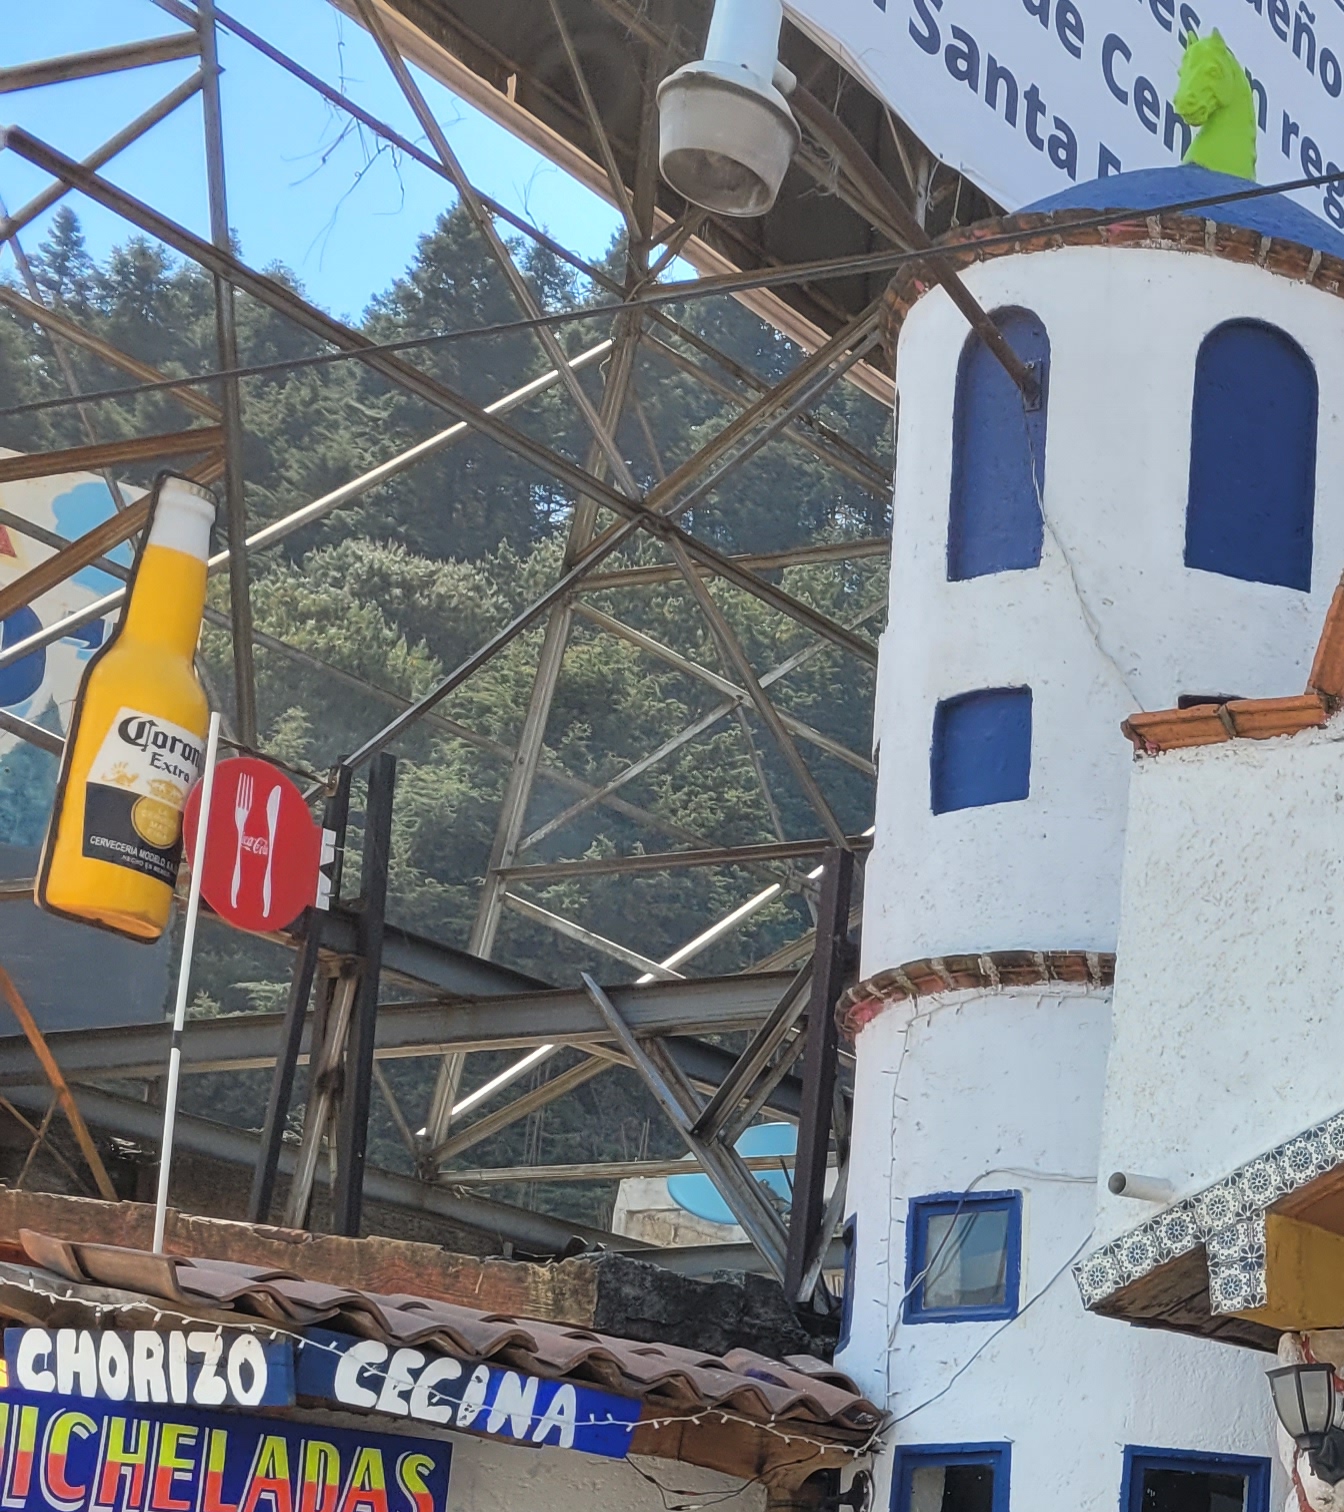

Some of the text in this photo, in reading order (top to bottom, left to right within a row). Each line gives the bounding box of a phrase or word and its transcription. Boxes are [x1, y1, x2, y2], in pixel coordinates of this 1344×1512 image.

[908, 0, 1077, 182] Santa
[118, 716, 205, 772] Coron
[150, 752, 190, 783] Extra
[17, 1327, 268, 1406] CHORIZO
[334, 1340, 577, 1449] CECINA
